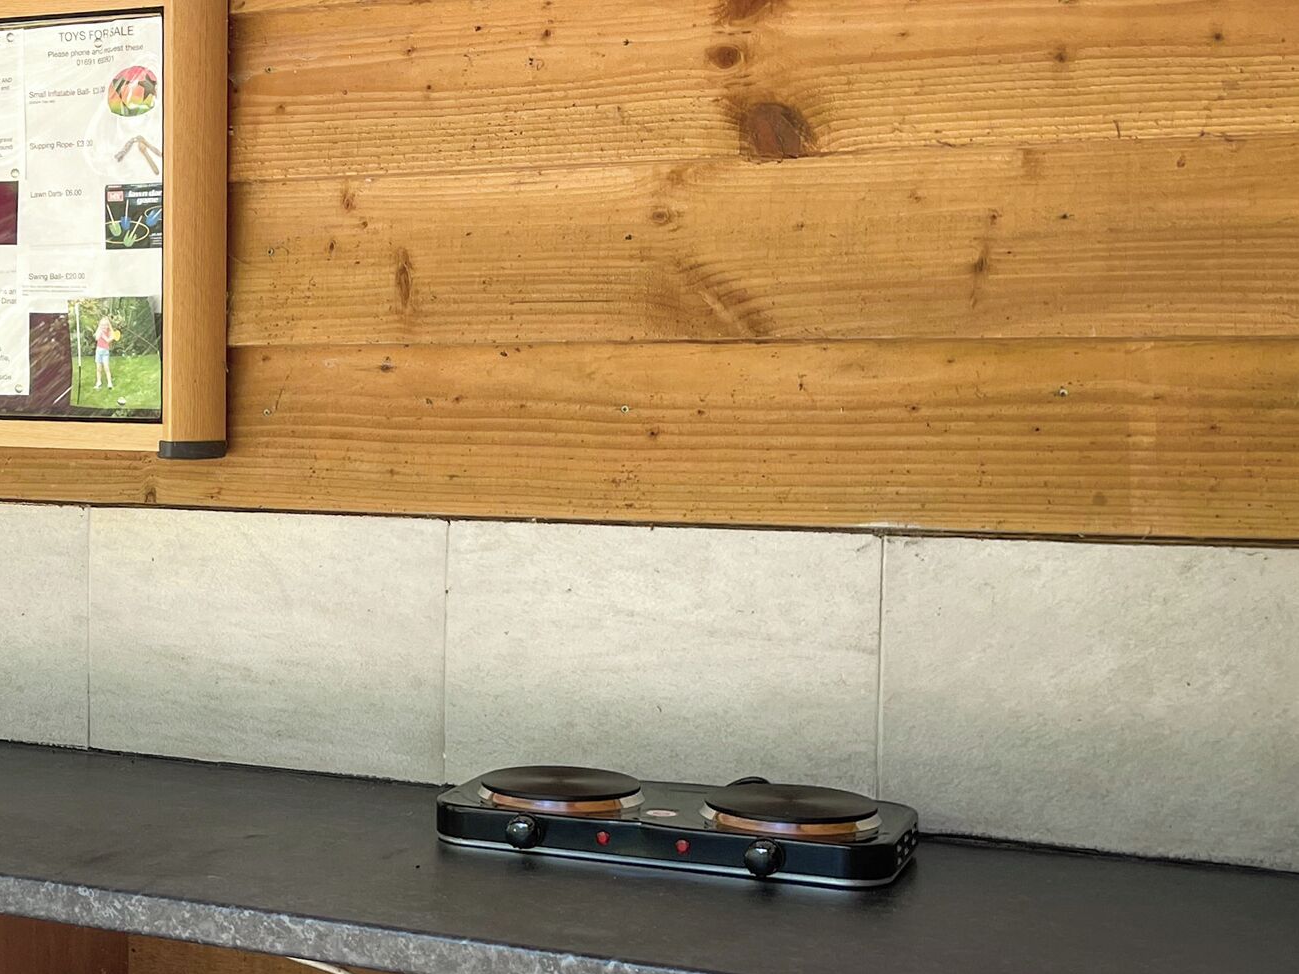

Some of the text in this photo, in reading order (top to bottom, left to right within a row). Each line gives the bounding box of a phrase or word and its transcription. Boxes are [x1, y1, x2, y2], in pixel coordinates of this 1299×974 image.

[59, 26, 134, 42] TOYS FOR SALE
[71, 48, 90, 57] phone
[48, 89, 75, 97] Inflatable
[29, 273, 48, 281] Swing
